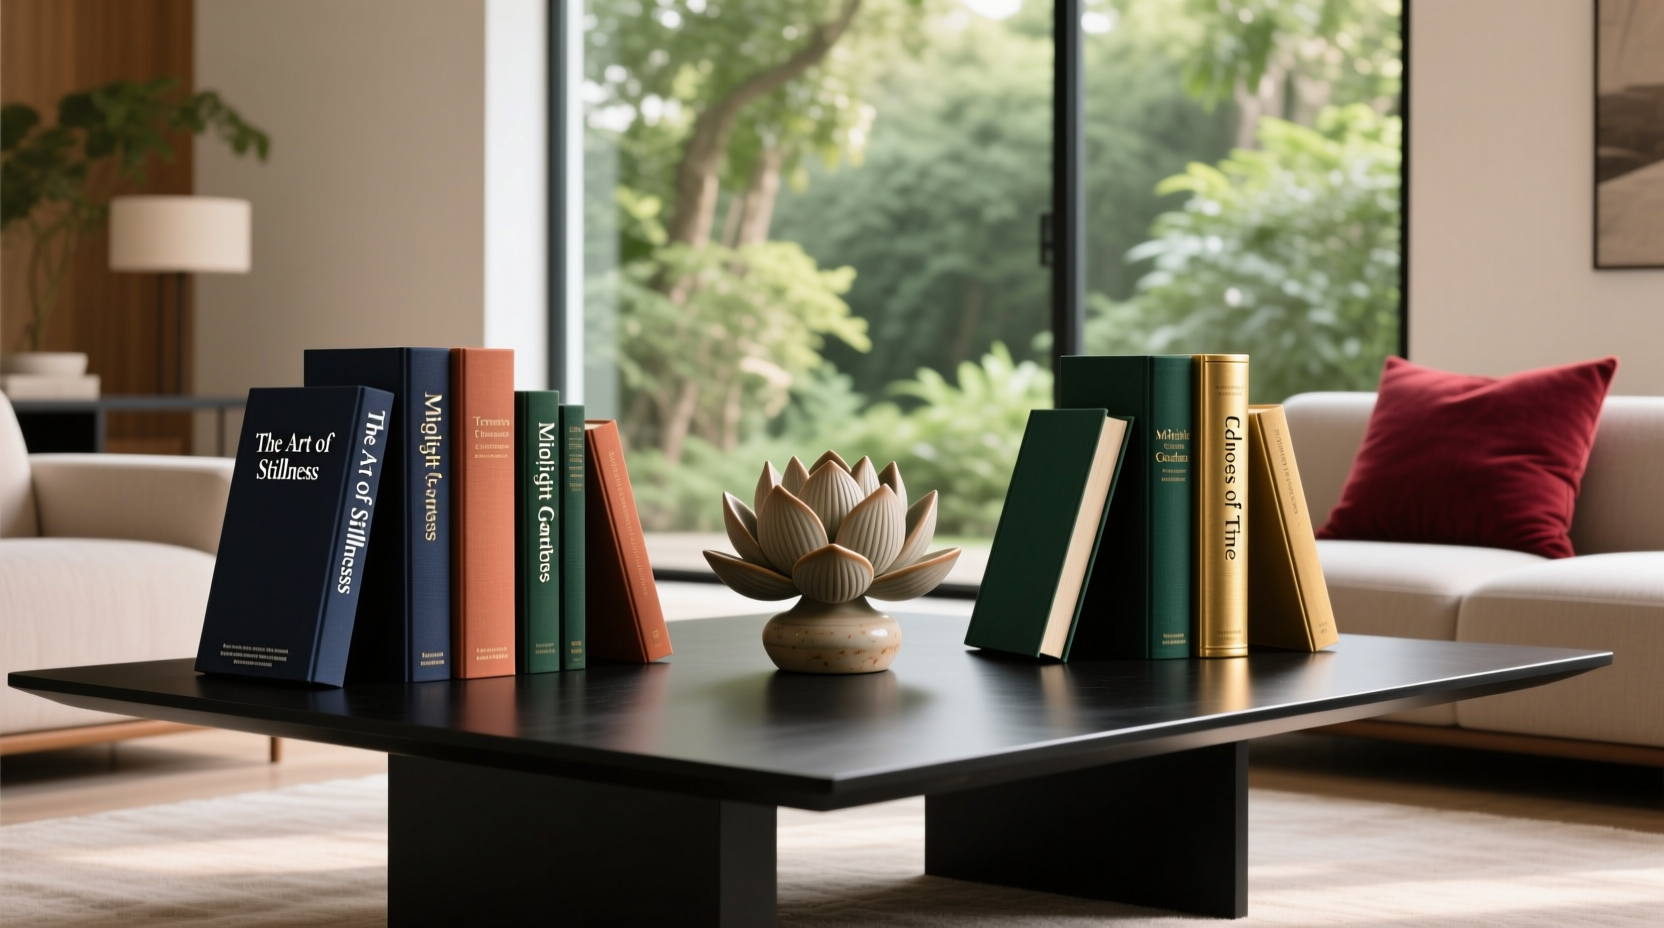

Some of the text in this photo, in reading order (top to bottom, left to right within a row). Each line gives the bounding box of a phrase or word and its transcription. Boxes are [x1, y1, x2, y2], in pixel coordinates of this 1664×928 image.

[363, 410, 386, 446] The
[255, 431, 336, 453] The Art of
[256, 457, 320, 481] Stillness
[355, 481, 373, 506] of
[1224, 490, 1242, 510] of
